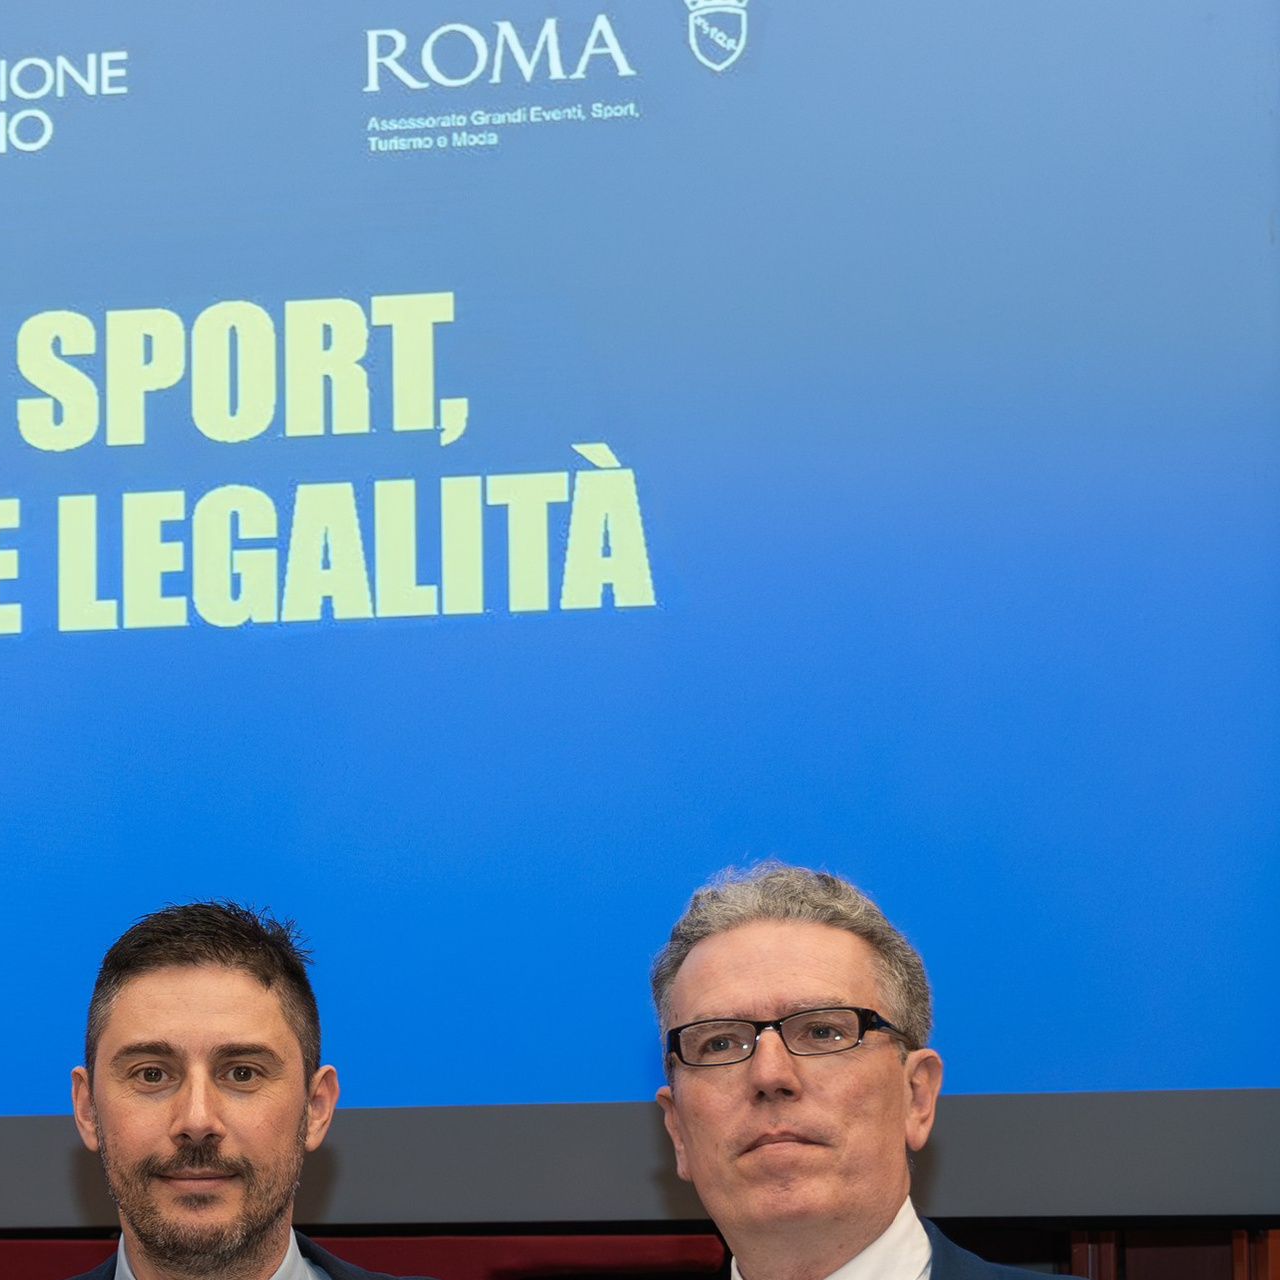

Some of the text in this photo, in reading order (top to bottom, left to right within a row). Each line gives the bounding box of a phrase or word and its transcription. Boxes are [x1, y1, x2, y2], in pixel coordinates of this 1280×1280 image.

[363, 14, 637, 92] ROMA
[368, 101, 640, 132] Assessorato Grandi Eventi, Sport,
[368, 131, 499, 152] Turismo e Moda
[15, 290, 469, 454] SPORT,
[56, 441, 657, 633] LEGALITÀ
